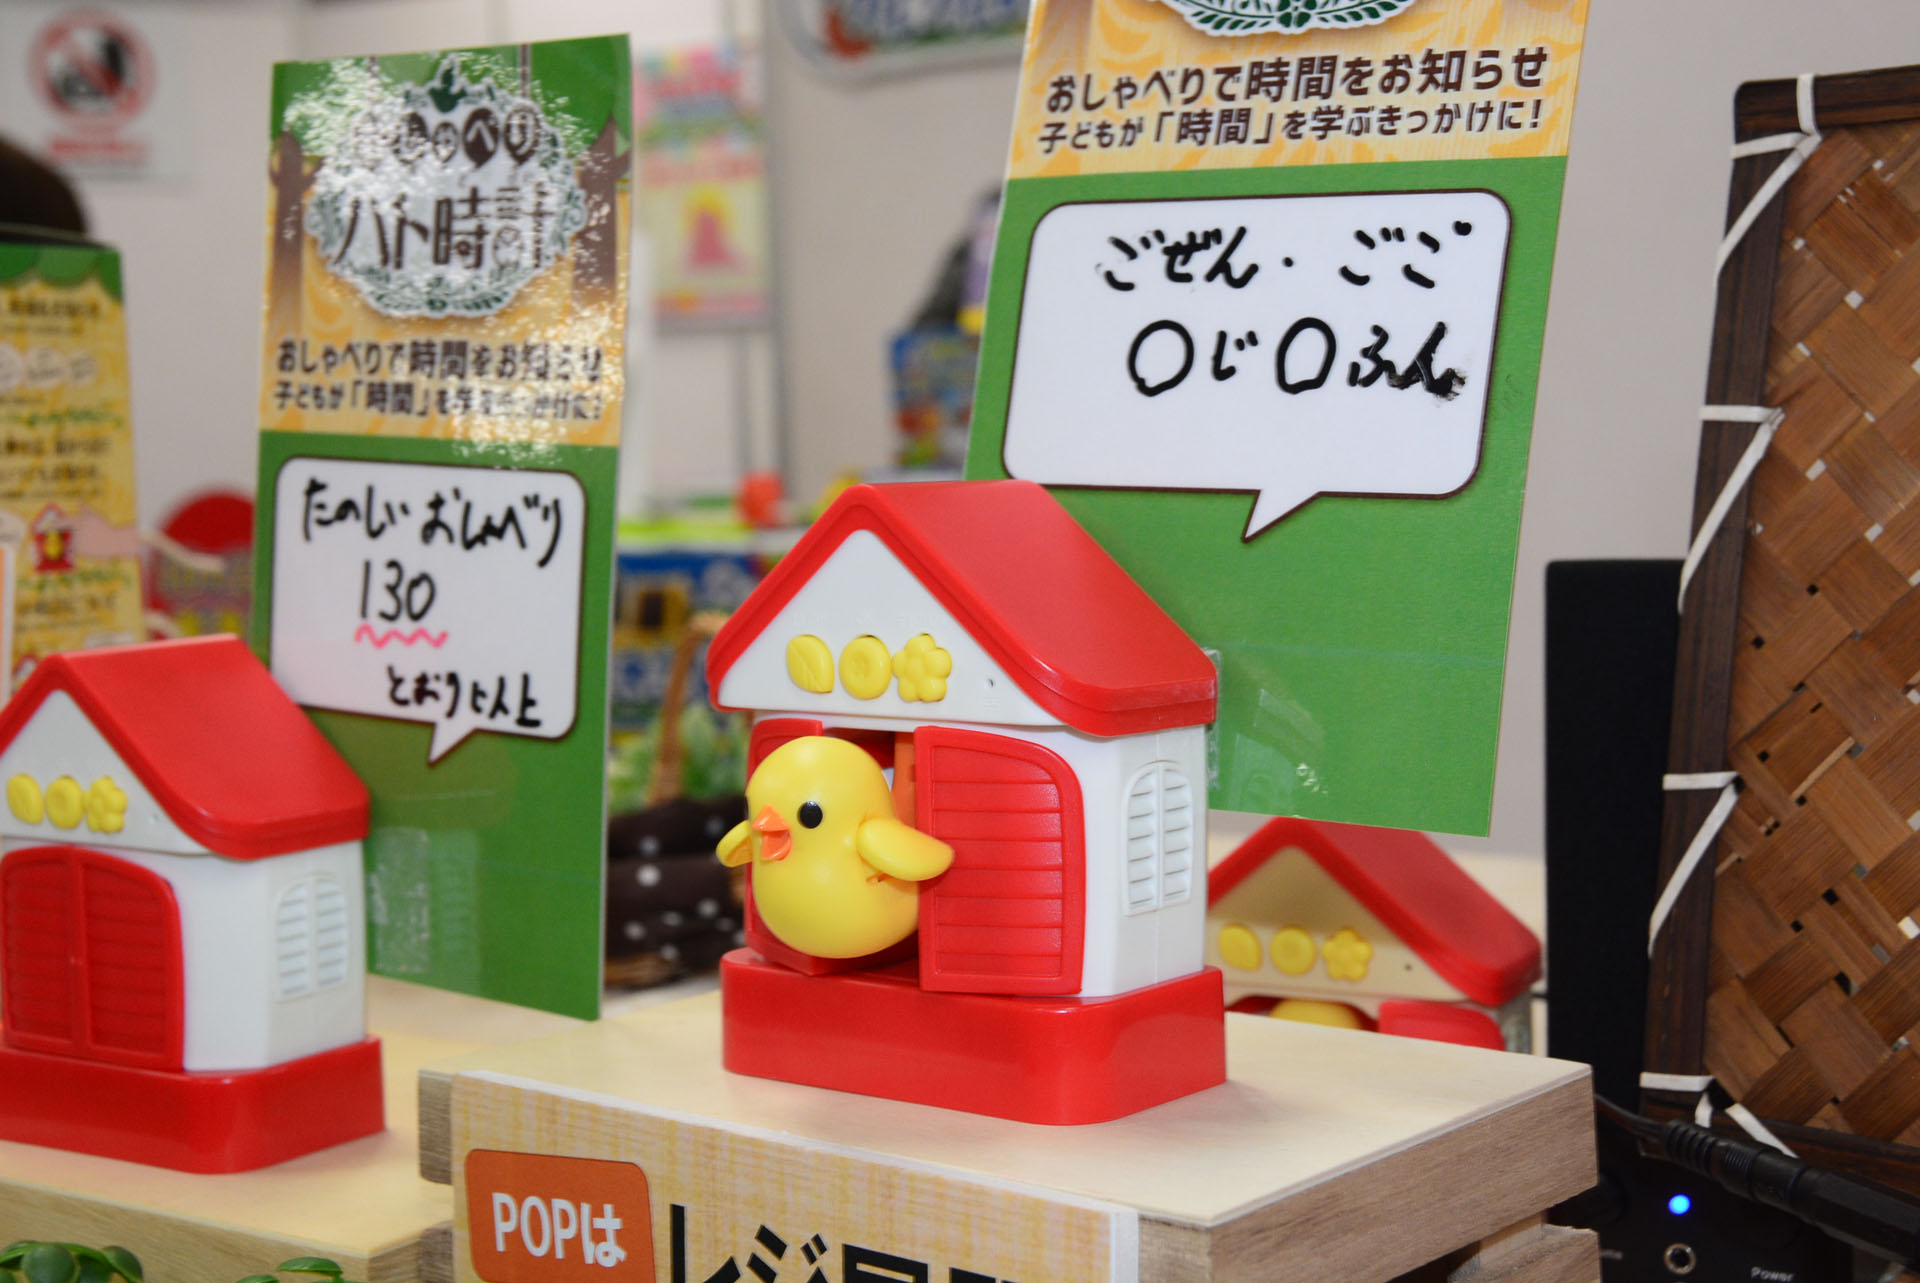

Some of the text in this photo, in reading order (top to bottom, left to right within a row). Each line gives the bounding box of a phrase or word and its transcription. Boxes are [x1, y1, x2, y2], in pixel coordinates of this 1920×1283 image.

[1046, 46, 1548, 114] おしゃべりで時間をお知らせ
[361, 558, 437, 622] 130
[491, 1192, 627, 1267] POPは
